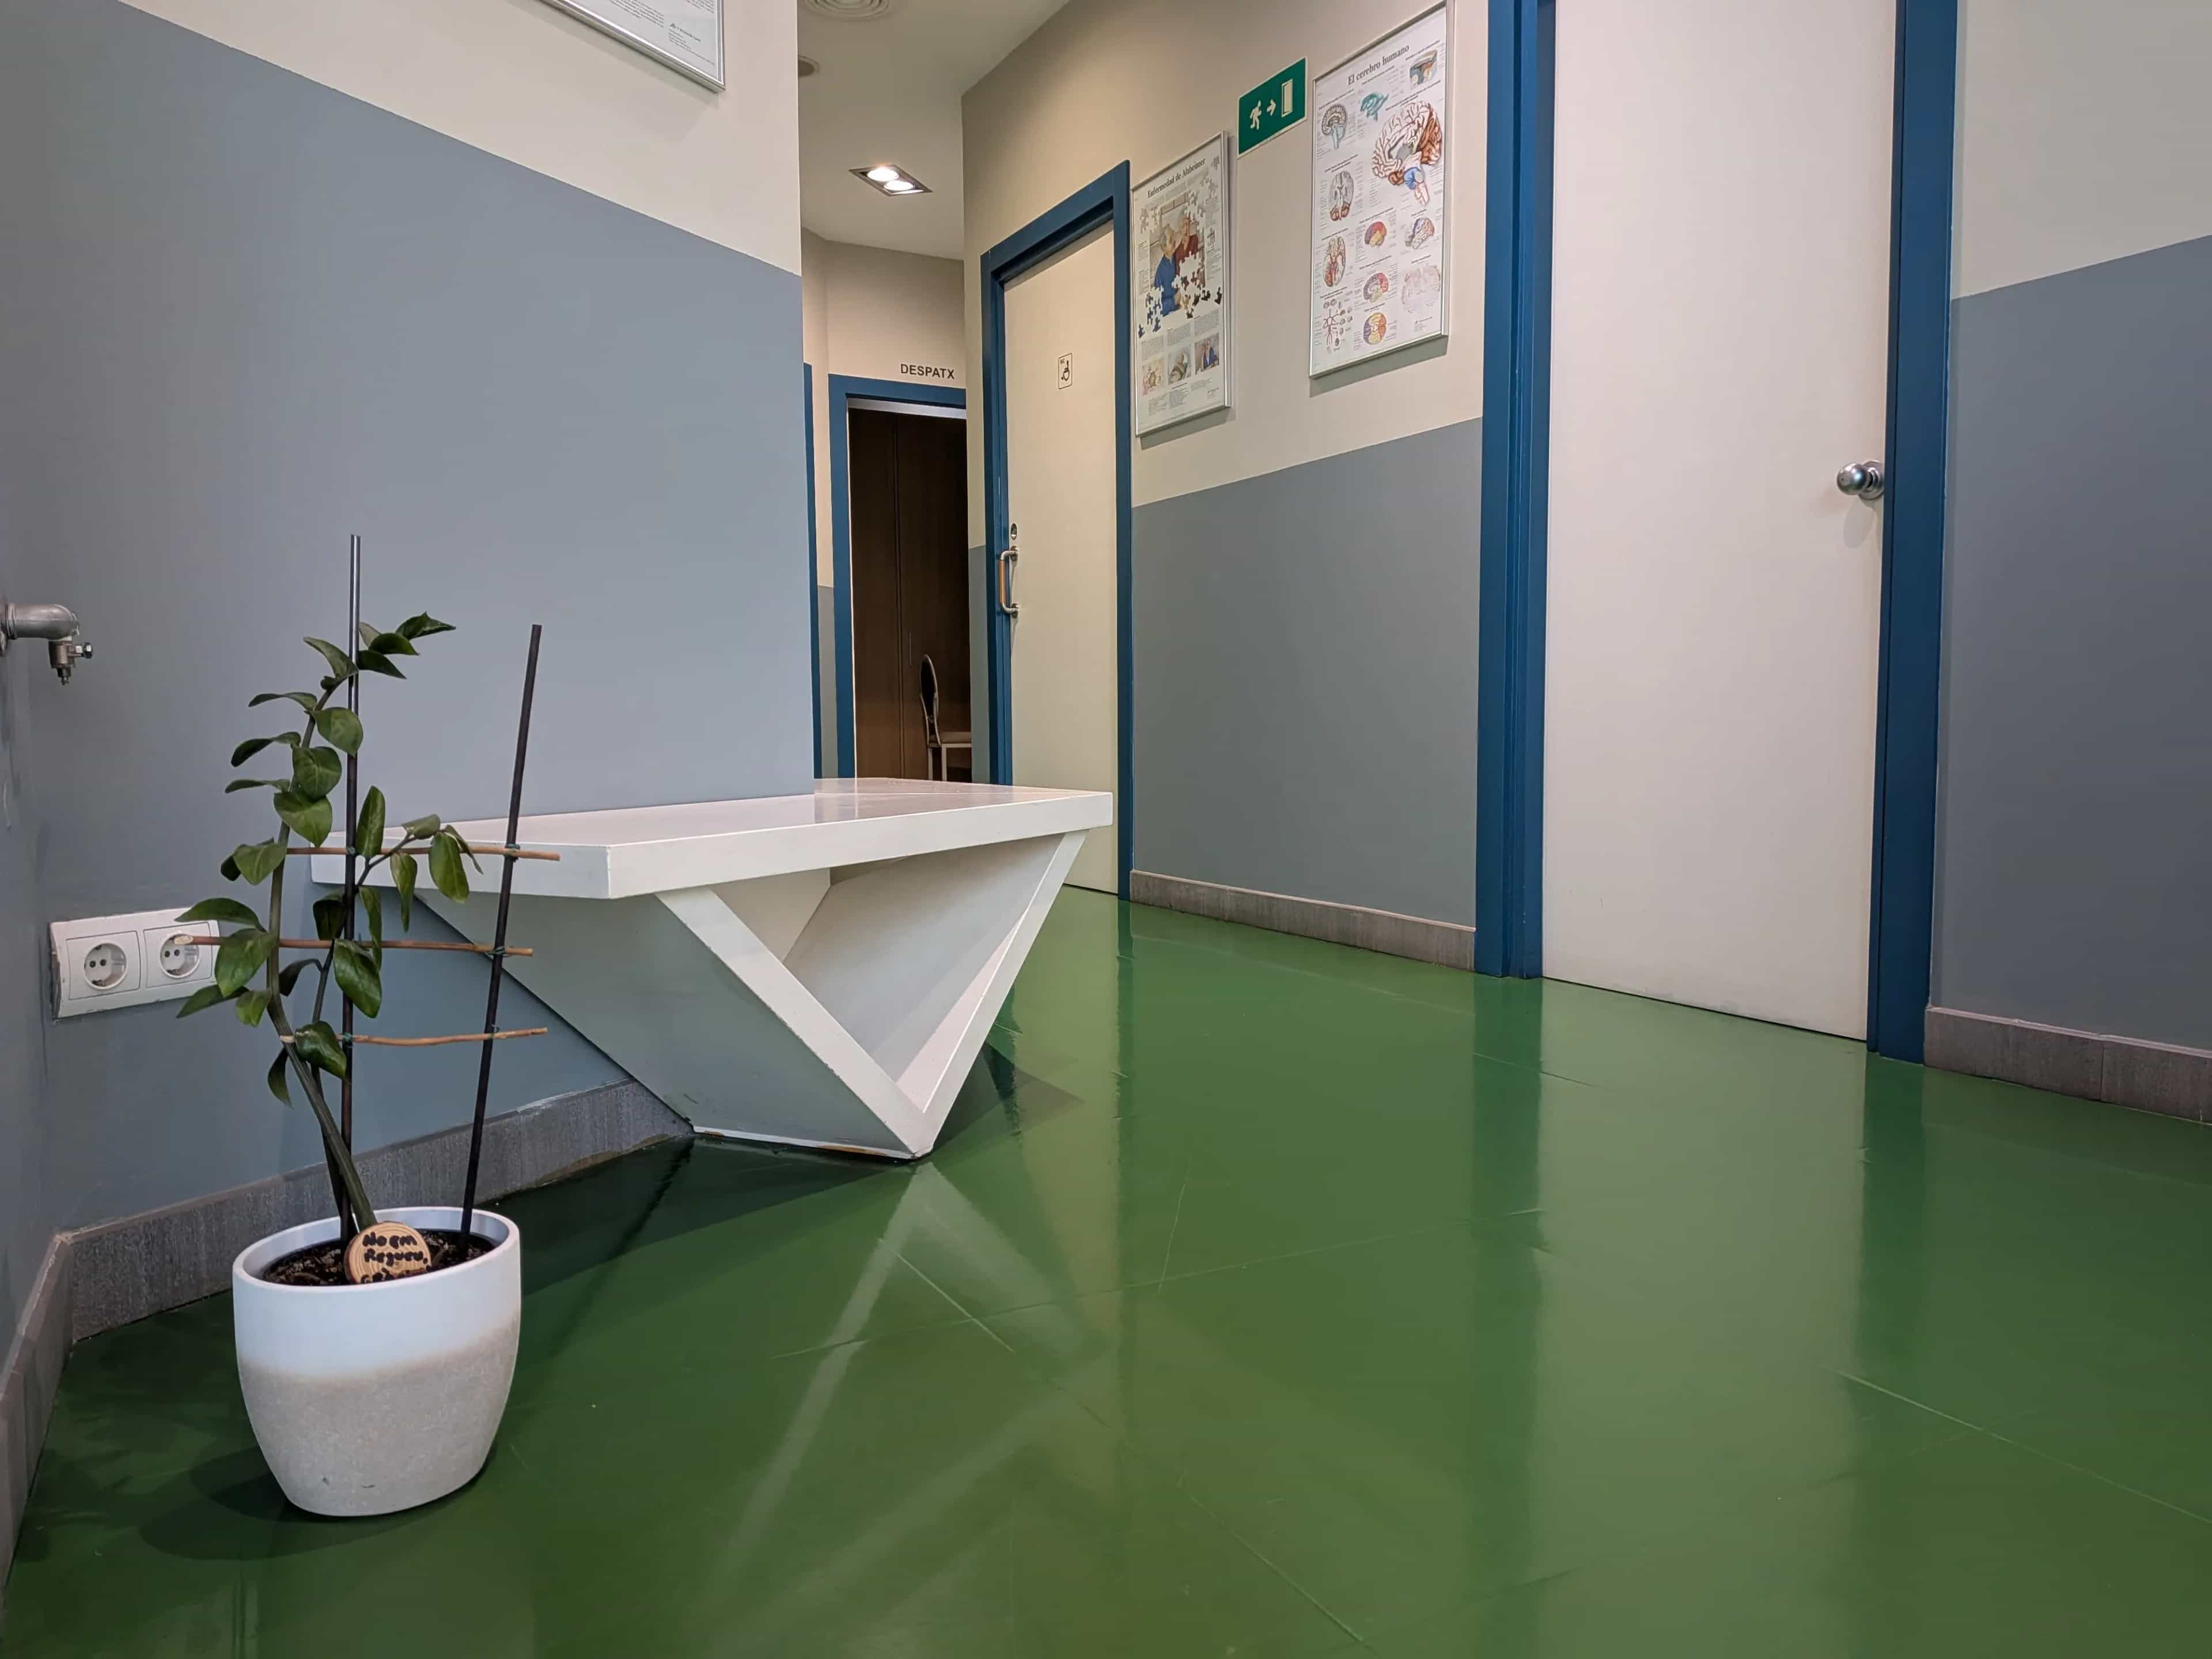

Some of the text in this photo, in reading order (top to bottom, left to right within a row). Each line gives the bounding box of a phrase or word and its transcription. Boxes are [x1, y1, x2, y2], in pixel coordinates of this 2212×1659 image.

[1348, 74, 1355, 85] El
[1356, 62, 1381, 80] cerebro
[1382, 45, 1410, 66] humano
[900, 363, 955, 379] DESPATX
